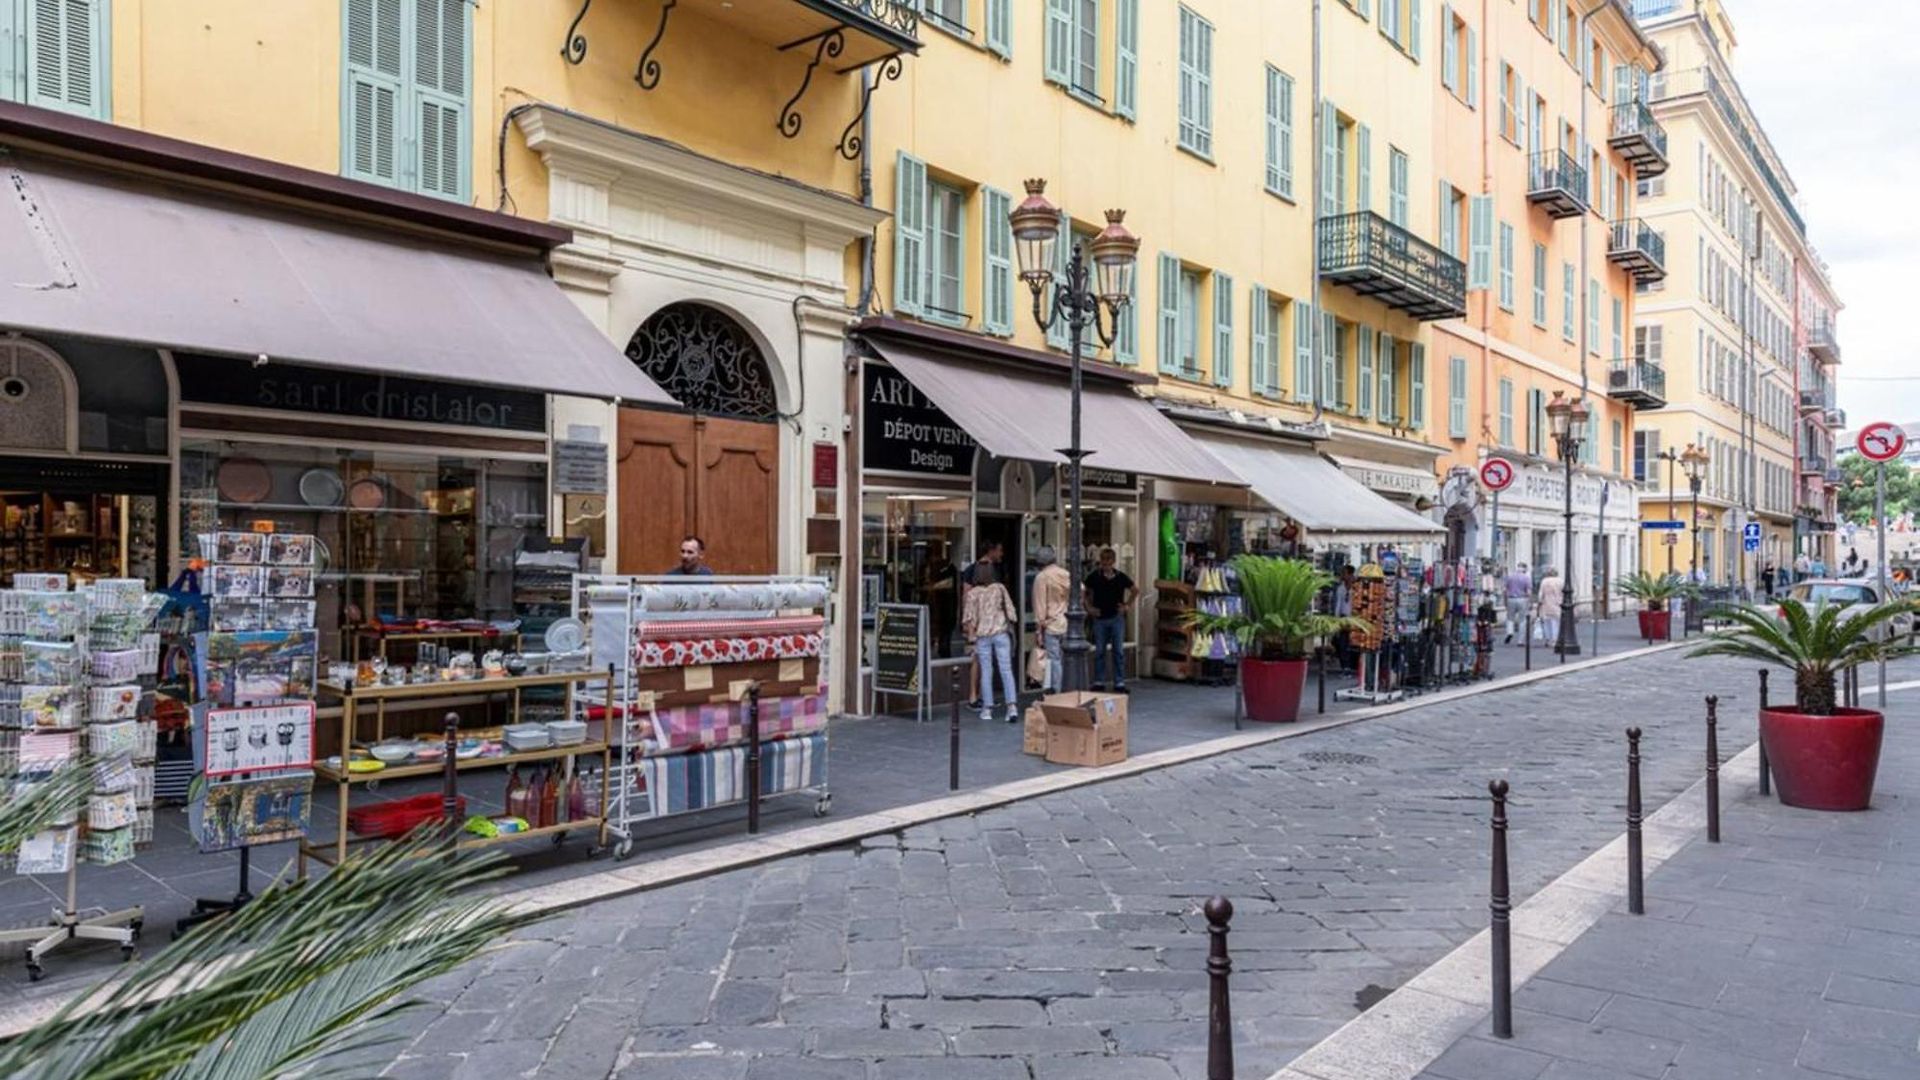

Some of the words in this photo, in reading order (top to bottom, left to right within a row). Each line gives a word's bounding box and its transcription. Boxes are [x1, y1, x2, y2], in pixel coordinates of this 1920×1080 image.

[871, 376, 914, 407] ART
[884, 417, 931, 442] DÉPOT
[911, 448, 953, 471] Design
[1360, 471, 1371, 486] LE
[1375, 474, 1421, 490] MAKASSAR
